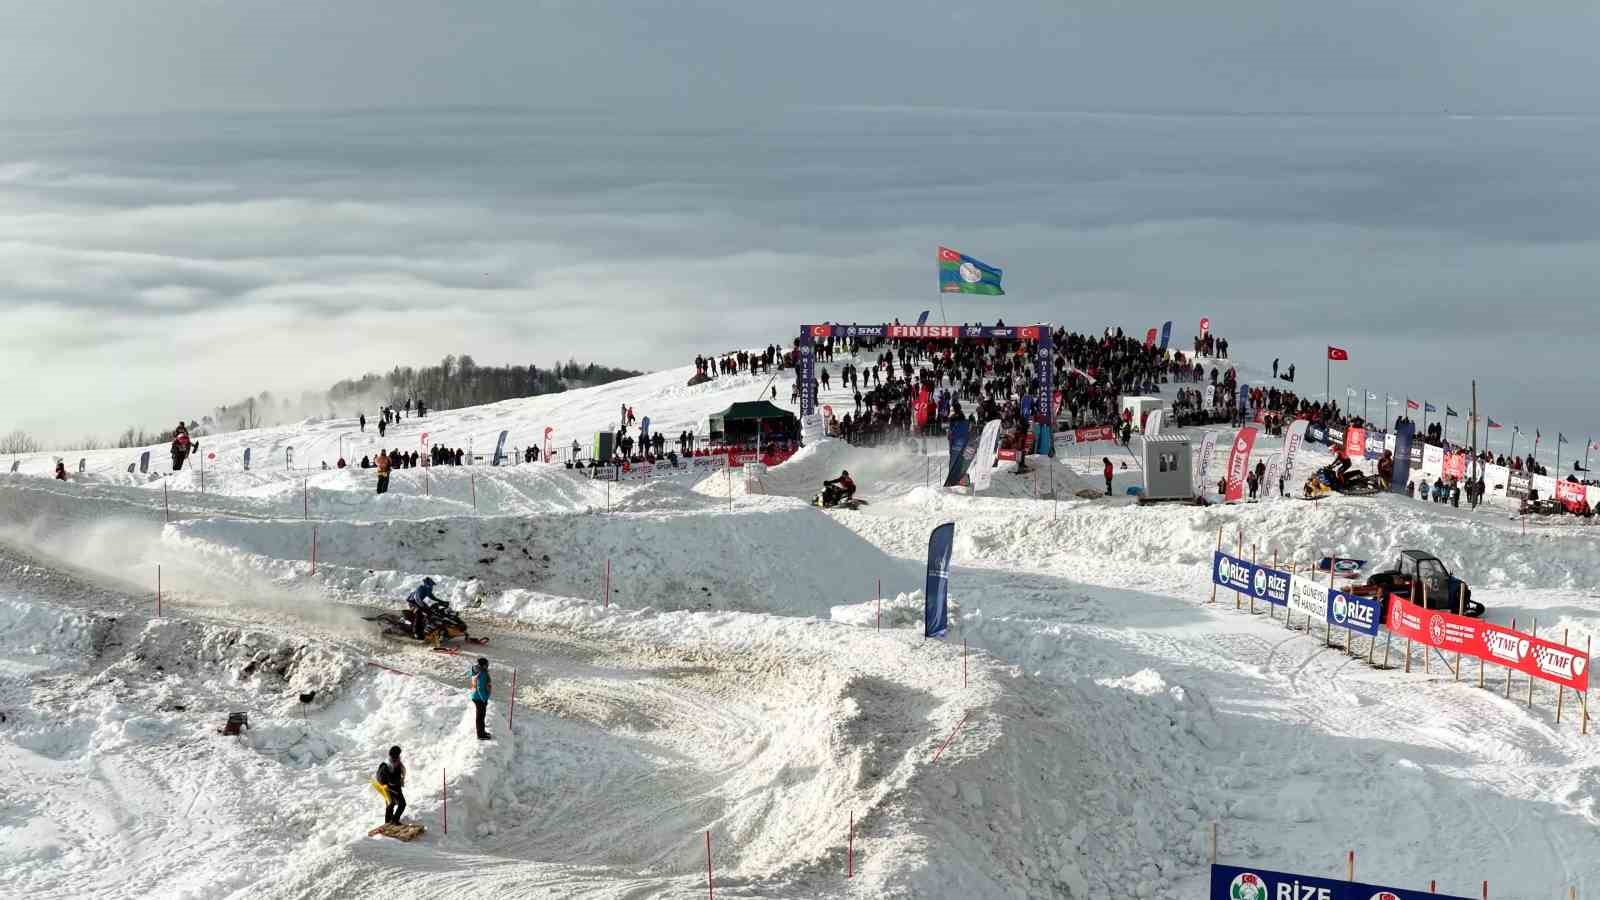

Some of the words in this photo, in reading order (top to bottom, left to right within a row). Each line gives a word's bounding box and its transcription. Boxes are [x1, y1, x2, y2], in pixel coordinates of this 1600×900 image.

[858, 327, 882, 336] SNX
[893, 326, 953, 337] FINISH
[1230, 563, 1250, 584] RİZE
[1268, 573, 1287, 592] RİZE
[1347, 600, 1374, 623] RİZE
[1498, 637, 1517, 652] TMF
[1548, 652, 1570, 668] TMF
[1276, 880, 1331, 900] RİZE
